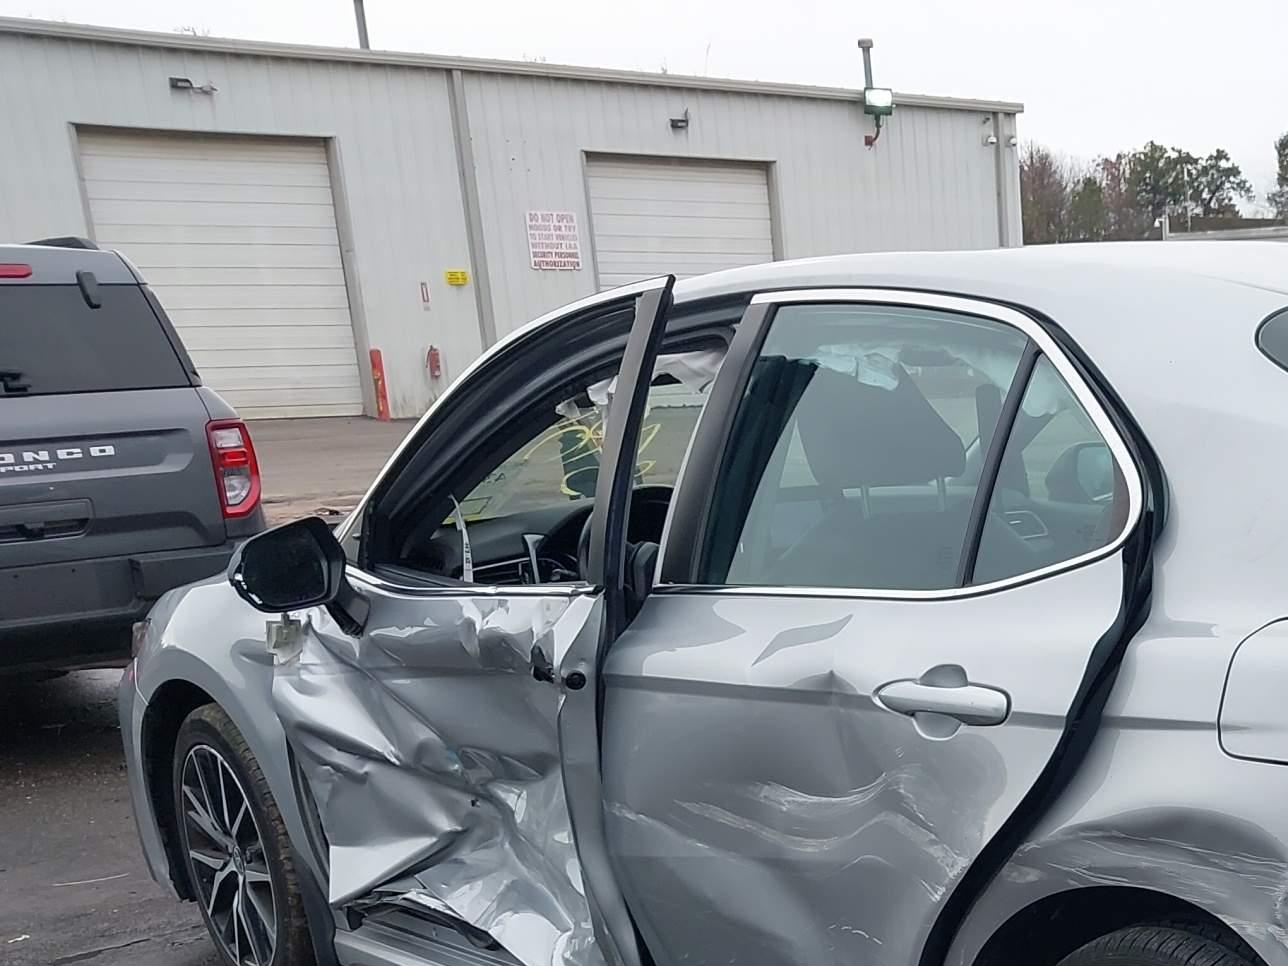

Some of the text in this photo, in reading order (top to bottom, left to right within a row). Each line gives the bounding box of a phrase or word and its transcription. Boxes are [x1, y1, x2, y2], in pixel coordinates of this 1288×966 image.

[529, 213, 575, 223] DO NOT OPEN
[552, 224, 562, 232] OR
[533, 260, 580, 268] AUTHORIZATION
